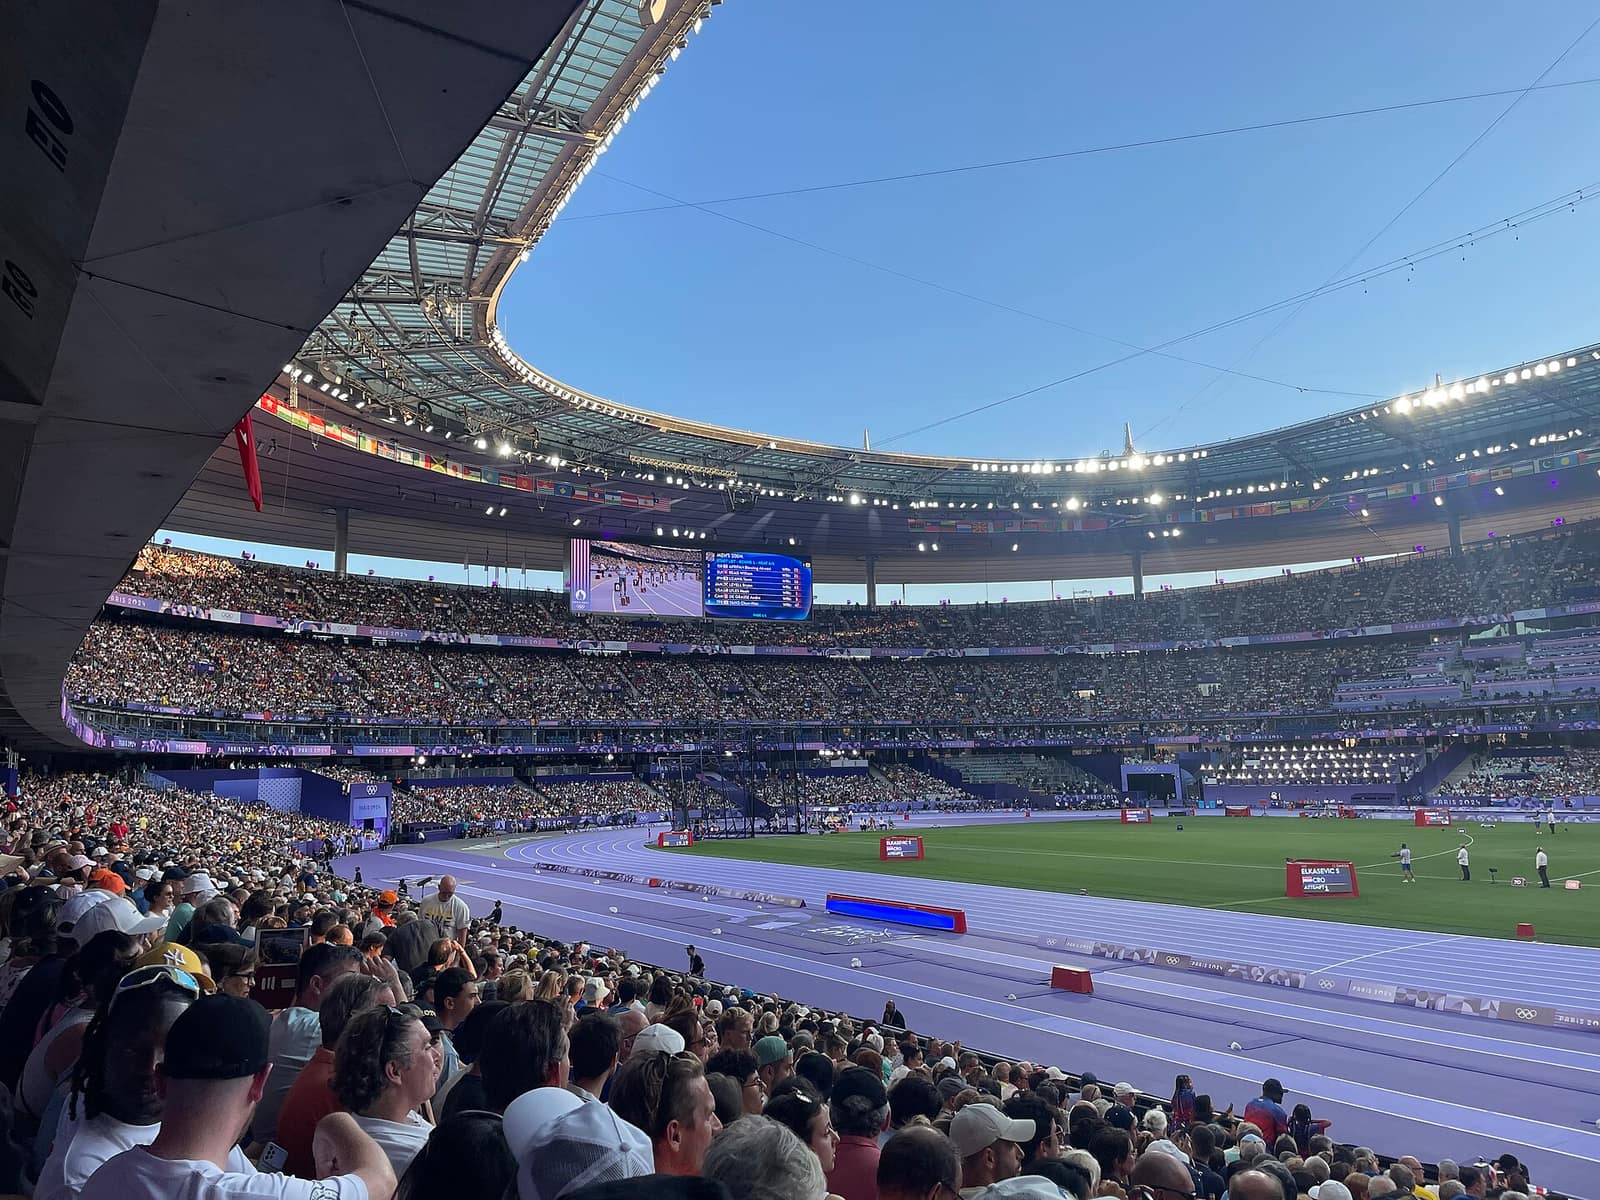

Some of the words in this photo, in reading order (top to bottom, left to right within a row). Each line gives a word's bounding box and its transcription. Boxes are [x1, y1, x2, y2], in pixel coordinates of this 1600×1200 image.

[1301, 867, 1335, 875] ELKASEVIC
[1352, 985, 1372, 994] PARIS
[1558, 1014, 1584, 1026] PARIS
